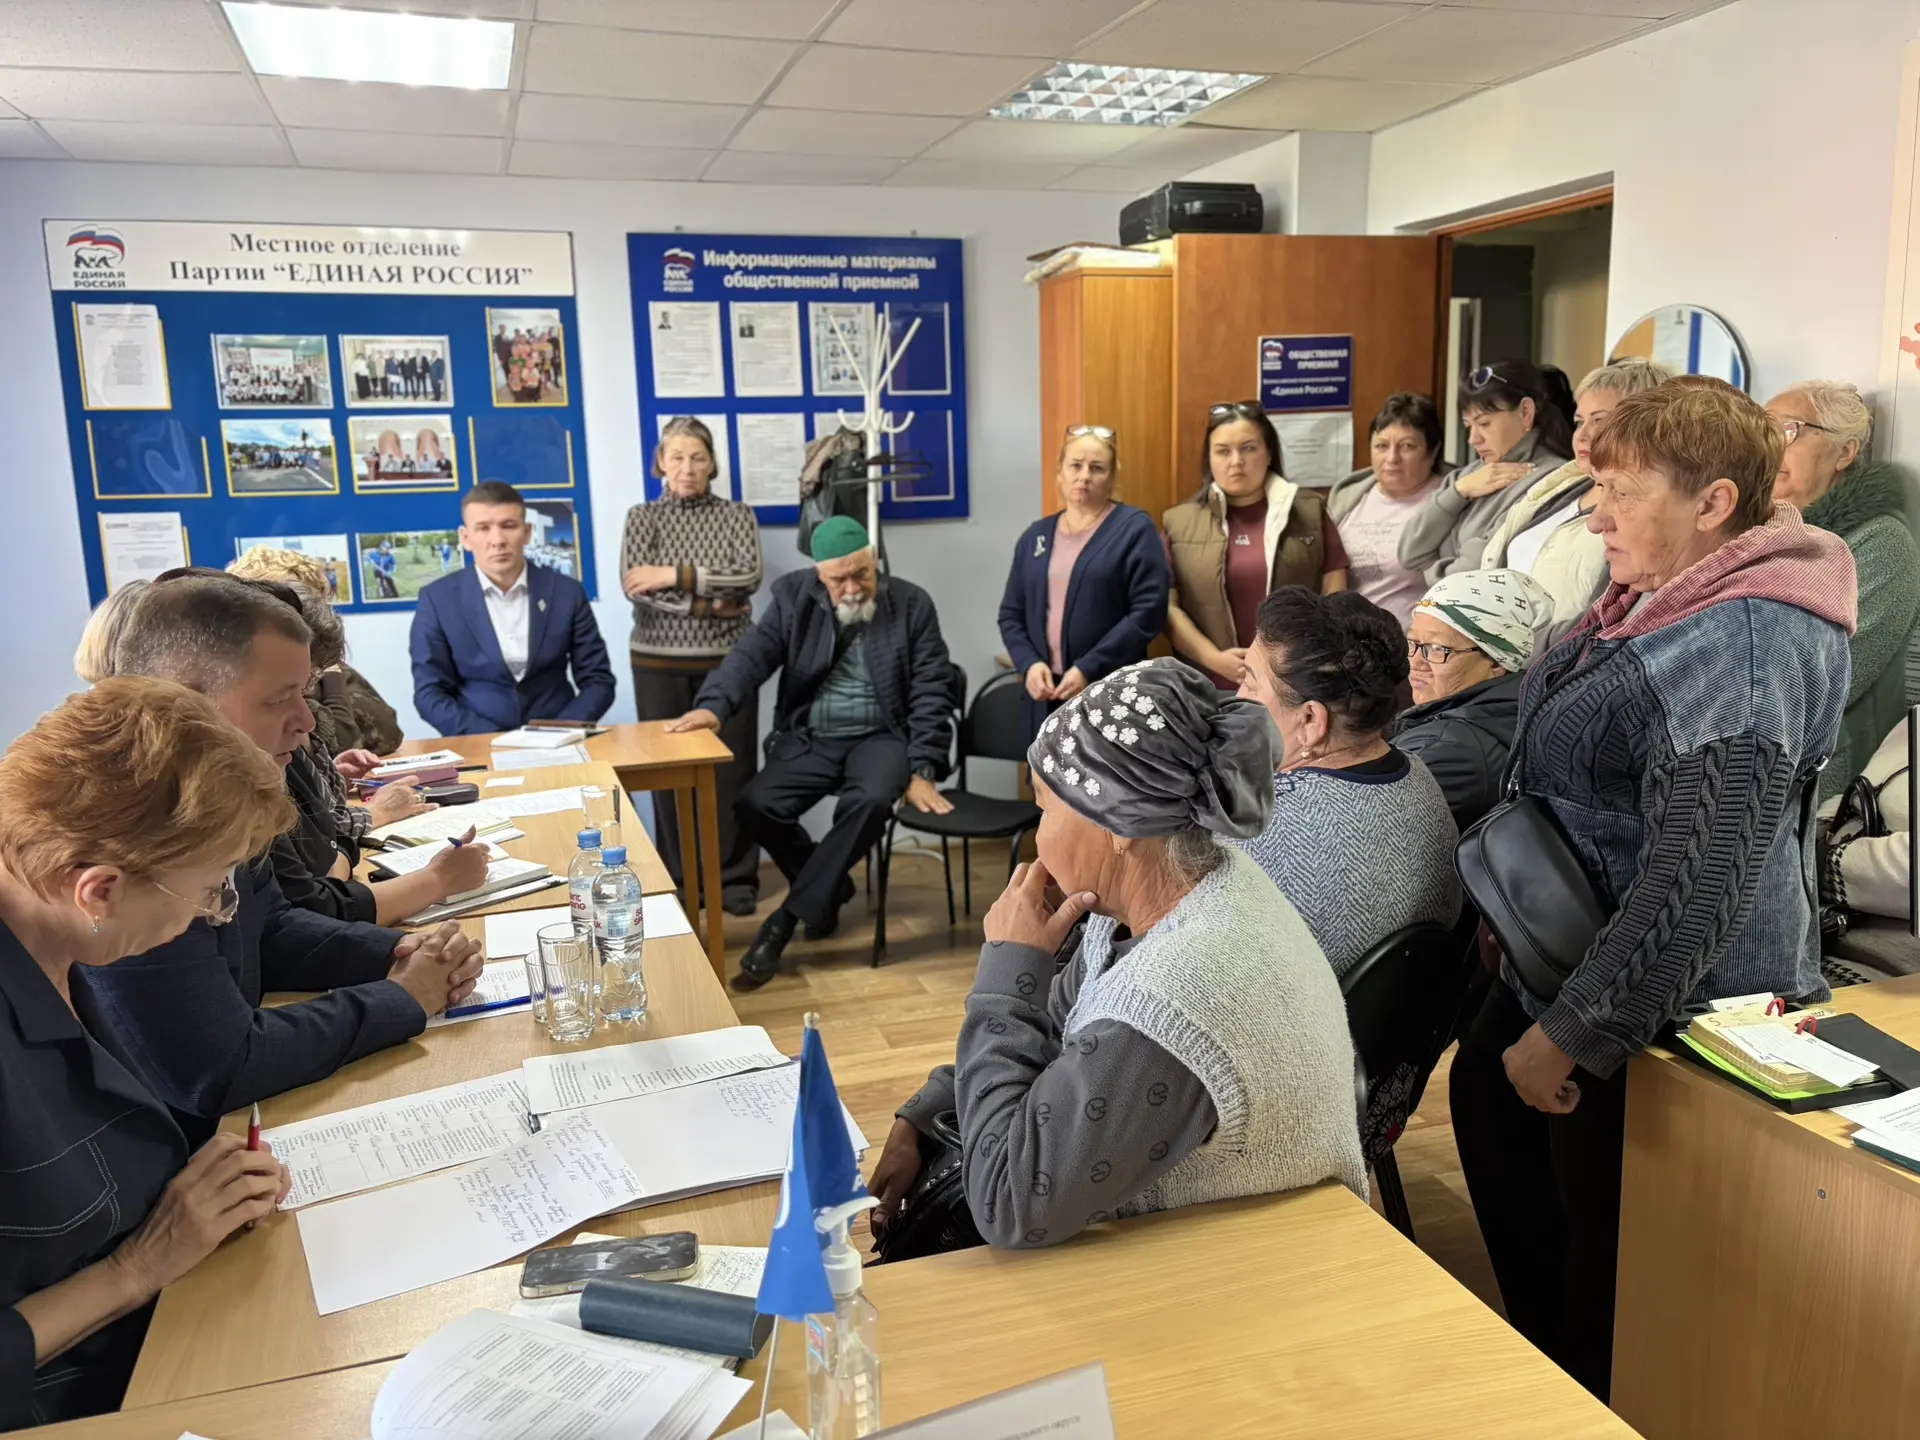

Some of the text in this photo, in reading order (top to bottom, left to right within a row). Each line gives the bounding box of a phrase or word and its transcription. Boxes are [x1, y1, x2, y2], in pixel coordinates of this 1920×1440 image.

[229, 232, 461, 257] Местное отделение
[702, 249, 937, 272] Информационные материалы
[73, 270, 126, 280] ЕДИНАЯ
[169, 260, 266, 285] Партии
[74, 280, 127, 289] РОССИЯ
[723, 270, 920, 293] общественной приемной
[1288, 348, 1349, 360] ОБЩЕСТВЕННАЯ
[1297, 359, 1339, 370] ПРИЕМНАЯ
